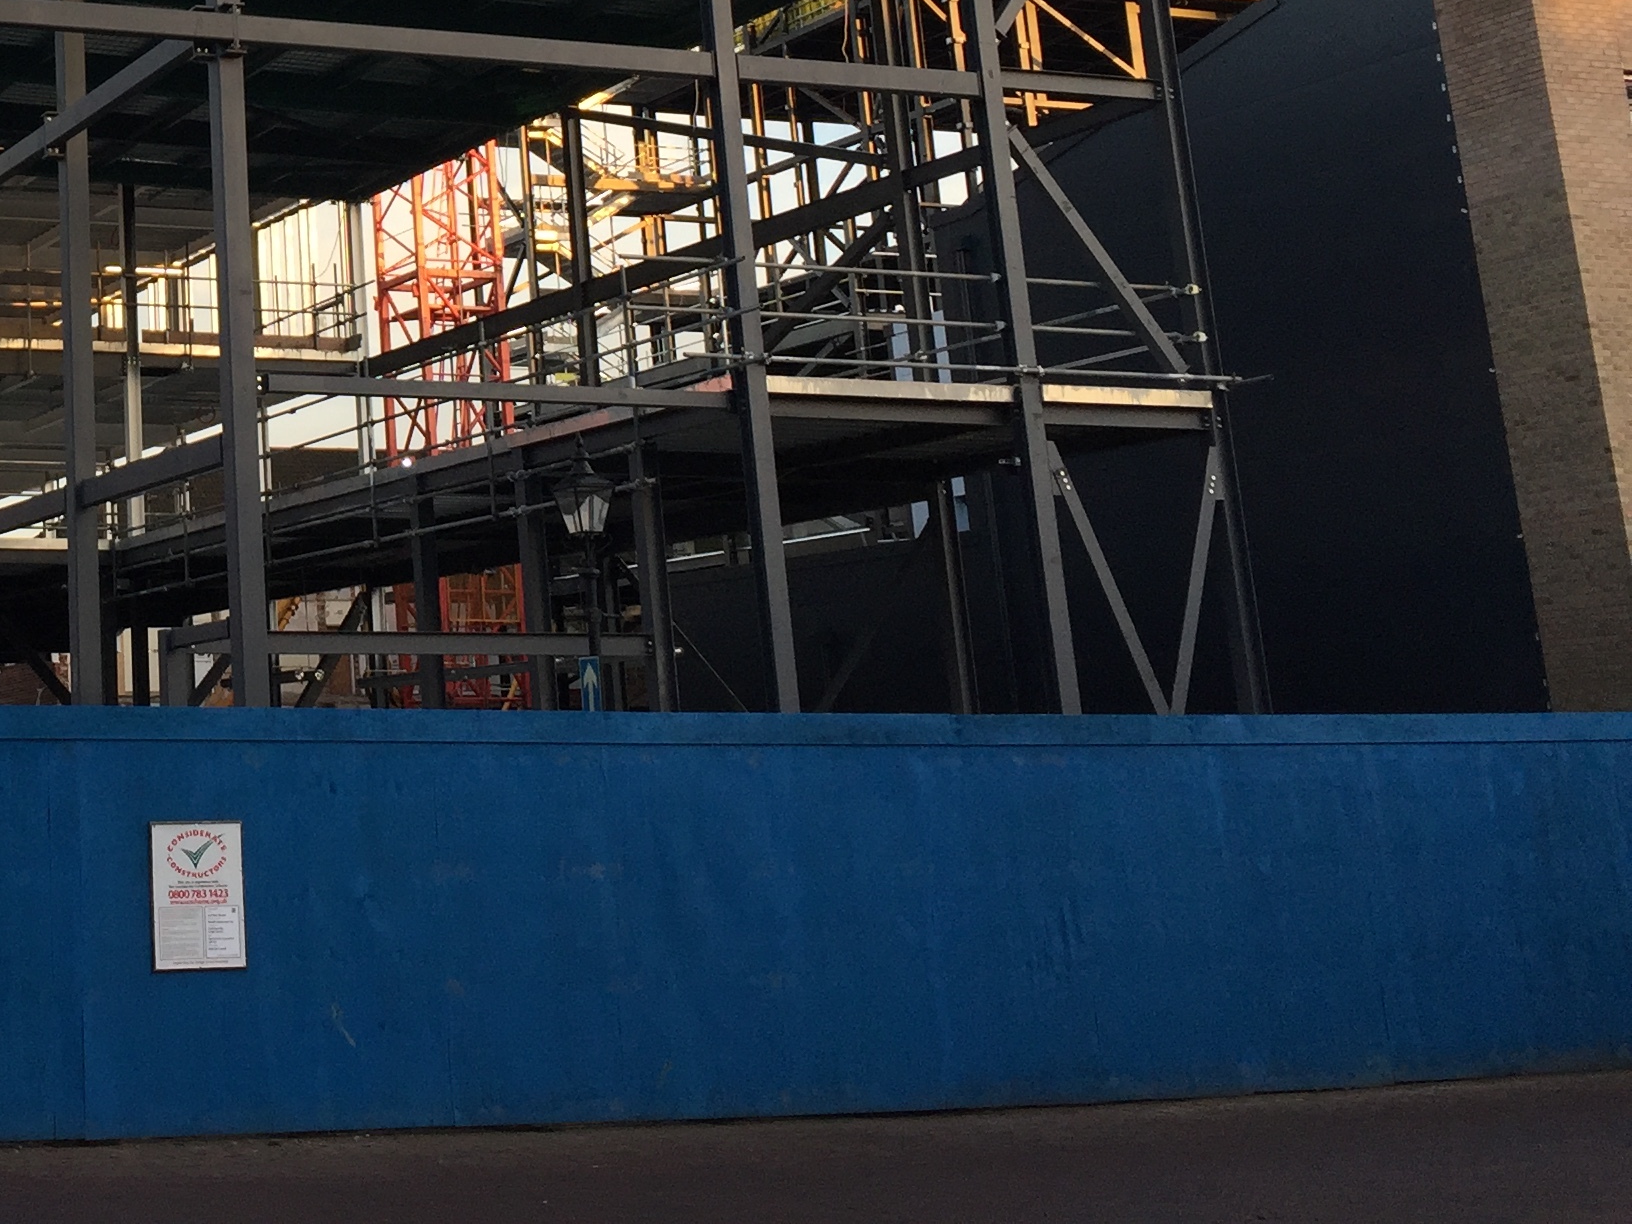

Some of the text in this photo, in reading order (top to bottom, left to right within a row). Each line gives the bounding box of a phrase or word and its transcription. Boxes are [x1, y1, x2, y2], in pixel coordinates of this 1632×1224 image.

[167, 829, 227, 853] CONSIDERATE
[166, 855, 227, 879] CONSTRUCTORS
[168, 888, 229, 899] 0800 783 1423
